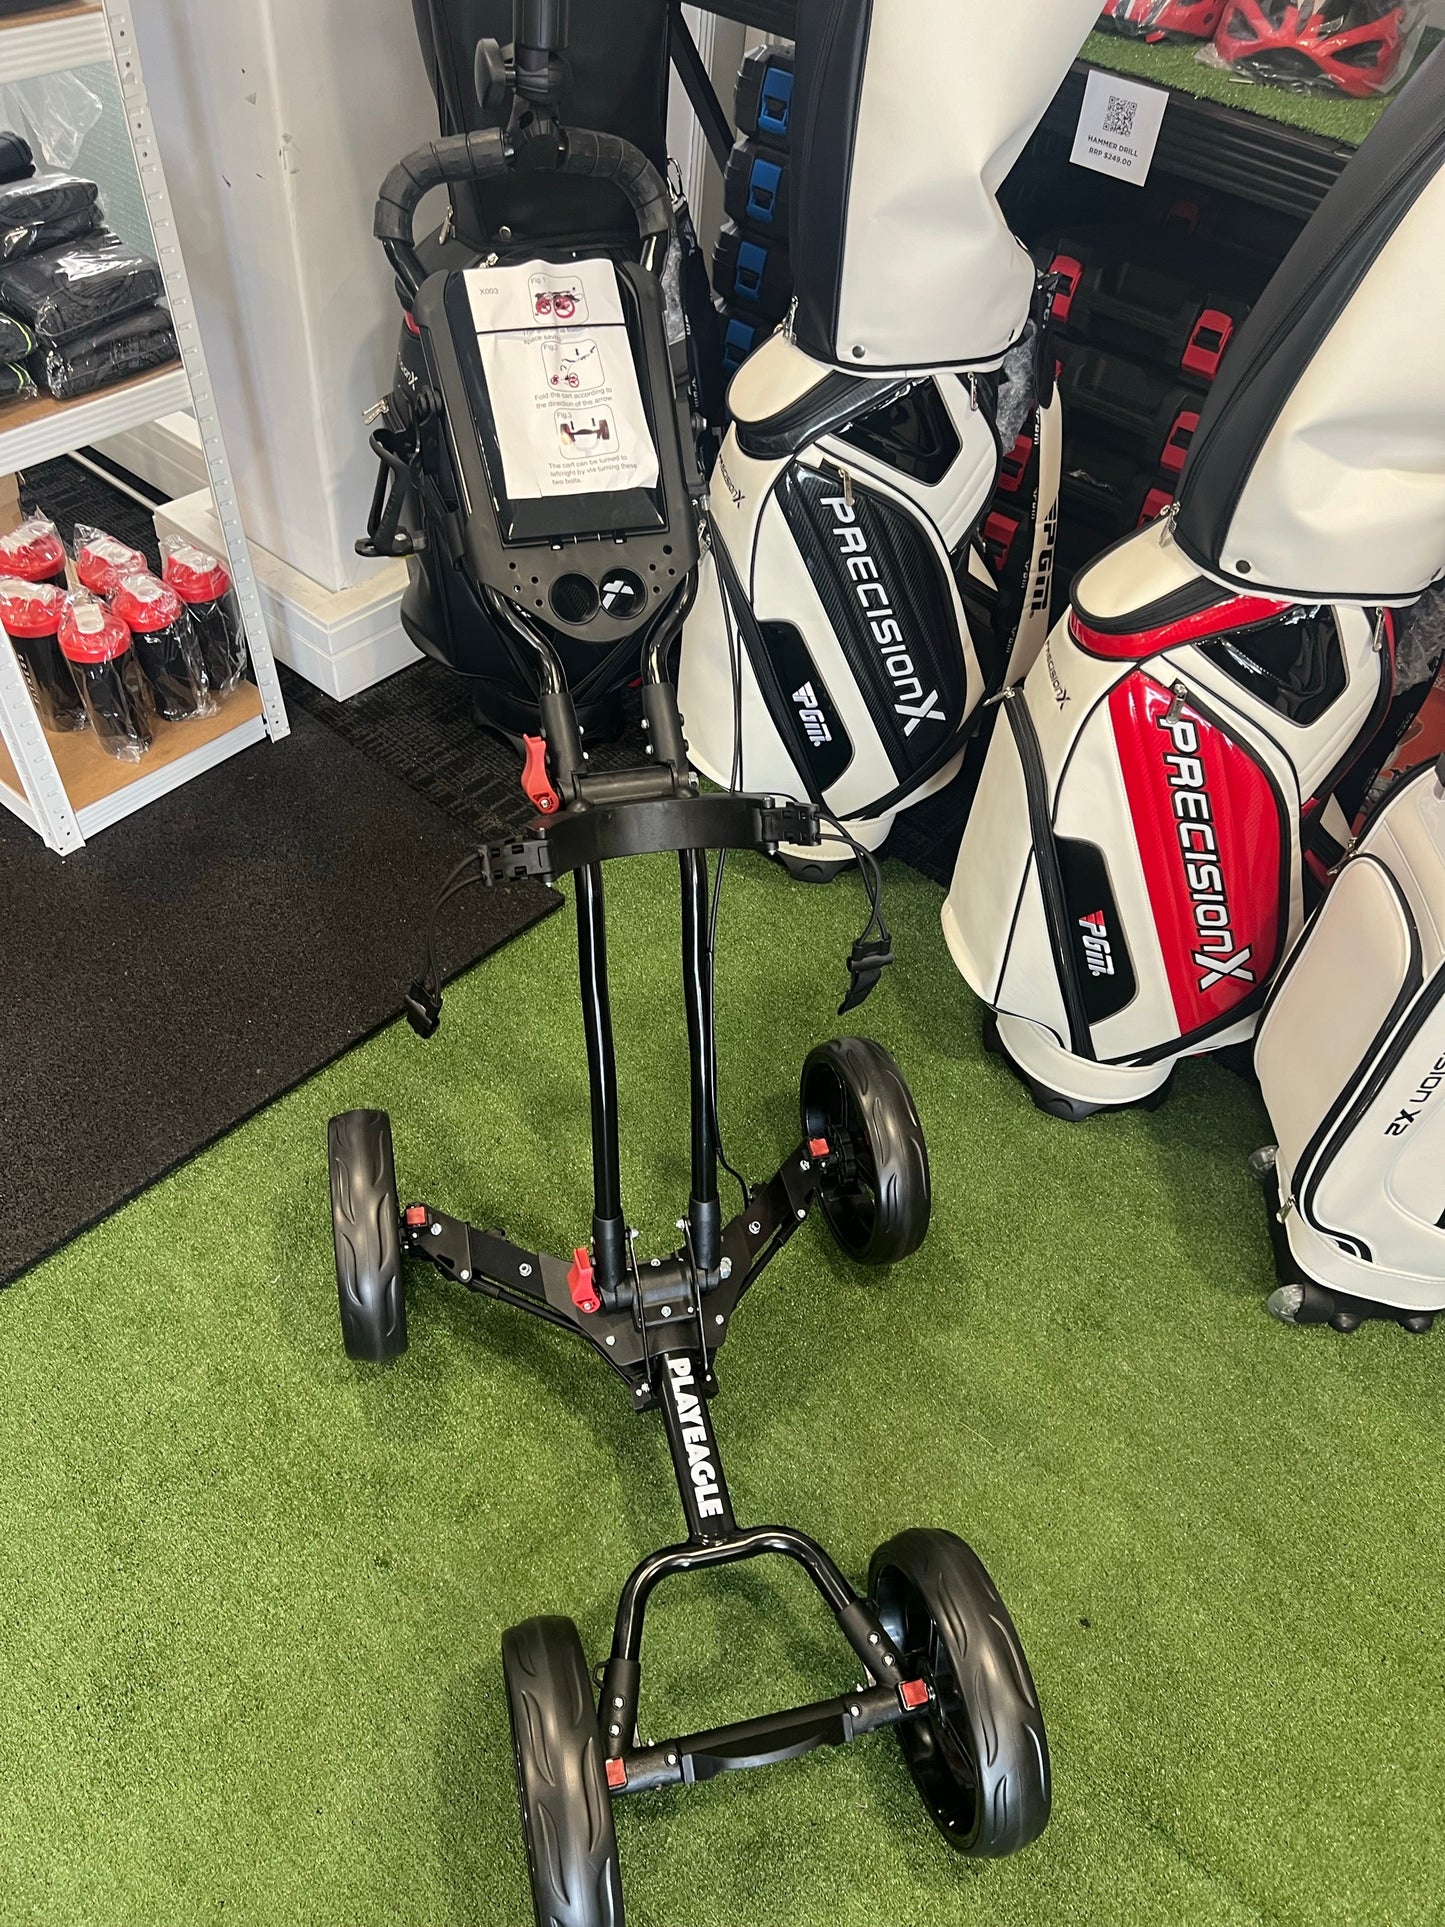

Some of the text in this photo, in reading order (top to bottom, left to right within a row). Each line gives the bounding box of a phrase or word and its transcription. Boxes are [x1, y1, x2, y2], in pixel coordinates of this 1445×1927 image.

[1088, 135, 1138, 157] HAMMER DRILL
[1089, 147, 1132, 166] RRP $249.00
[480, 287, 499, 295] X003
[534, 392, 549, 401] Fold
[573, 388, 605, 399] according
[536, 401, 547, 409] the
[548, 399, 574, 408] direction
[582, 398, 593, 406] the
[556, 411, 573, 420] Fig.3
[549, 461, 561, 470] The
[562, 460, 575, 468] cart
[576, 459, 588, 467] can
[599, 455, 620, 463] turned
[597, 463, 620, 472] turning
[621, 462, 638, 470] these
[551, 478, 564, 486] two
[819, 496, 947, 738] PRECISIONX
[1157, 714, 1257, 994] PRECISIONX
[1384, 1108, 1422, 1136] X2
[667, 1356, 724, 1519] PLAYEAGLE
